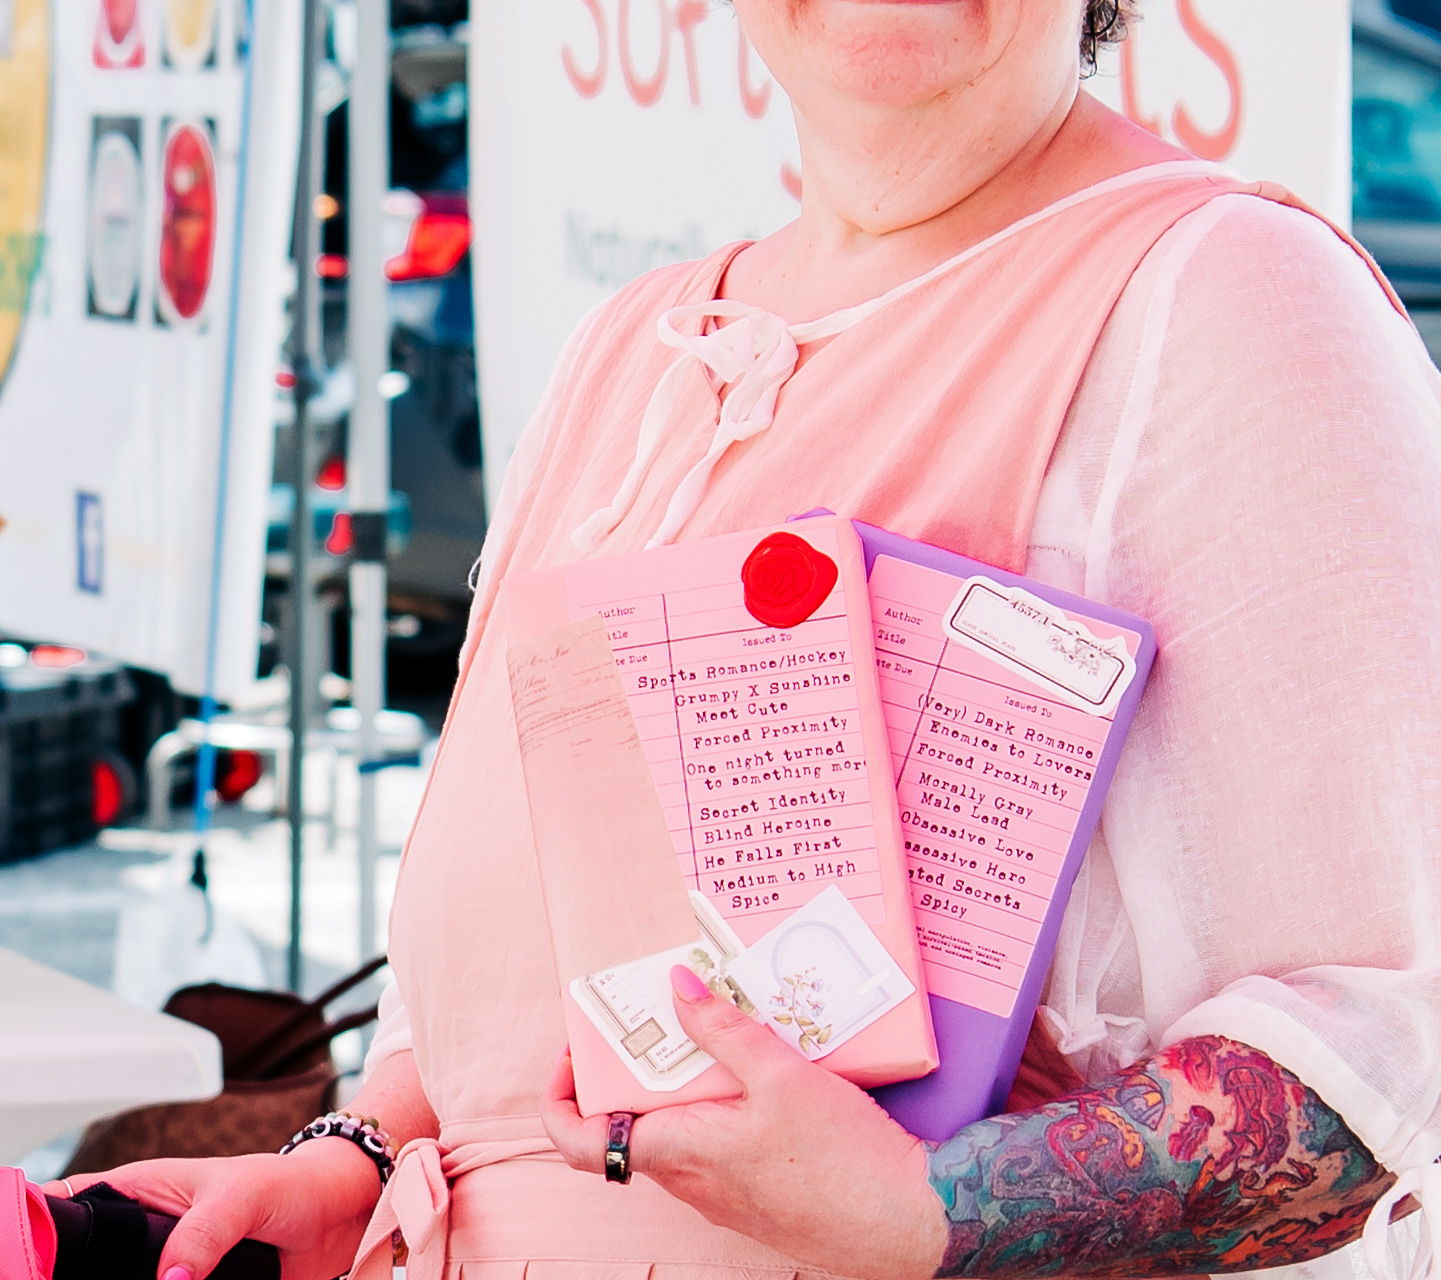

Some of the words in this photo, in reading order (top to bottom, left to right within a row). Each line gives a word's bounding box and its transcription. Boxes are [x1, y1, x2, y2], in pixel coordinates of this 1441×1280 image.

[884, 607, 924, 626] Author
[742, 634, 777, 648] Issued
[877, 628, 907, 646] Title
[637, 669, 697, 690] Sports
[706, 648, 848, 680] Romance/Hockey
[675, 687, 740, 708] Grumpy
[769, 672, 852, 696] Sunshine
[1004, 695, 1038, 716] Issued
[695, 706, 739, 724] Meet
[747, 701, 789, 717] Cute
[917, 692, 968, 721] (Very)
[973, 710, 1015, 736] Dark
[1023, 727, 1095, 760] Romance
[693, 728, 752, 750] Forced
[761, 715, 849, 740] Proximity
[687, 762, 717, 777] One
[725, 749, 775, 770] night
[782, 741, 846, 763] turned
[929, 719, 999, 753] Enemies
[1007, 742, 1026, 760] to
[1032, 753, 1093, 782] Lovers
[704, 778, 722, 791] to
[732, 764, 822, 787] something
[916, 742, 975, 770] Forced
[982, 761, 1068, 801] Proximity
[700, 799, 760, 822] Secret
[768, 787, 847, 811] Identity
[918, 771, 986, 805] Morally
[994, 795, 1035, 820] Gray
[920, 791, 961, 814] Male
[970, 806, 1010, 831] Lead
[704, 824, 753, 845] Blind
[762, 816, 832, 836] Heroine
[901, 810, 987, 847] Obsessive
[995, 837, 1035, 863] Love
[704, 855, 726, 870] He
[735, 846, 784, 864] Falls
[793, 835, 842, 856] First
[713, 873, 780, 894] Medium
[788, 868, 806, 883] to
[815, 860, 857, 878] High
[985, 861, 1027, 886] Hero
[731, 891, 781, 909] Spice
[920, 893, 968, 919] Spicy
[953, 879, 1022, 911] Secrets
